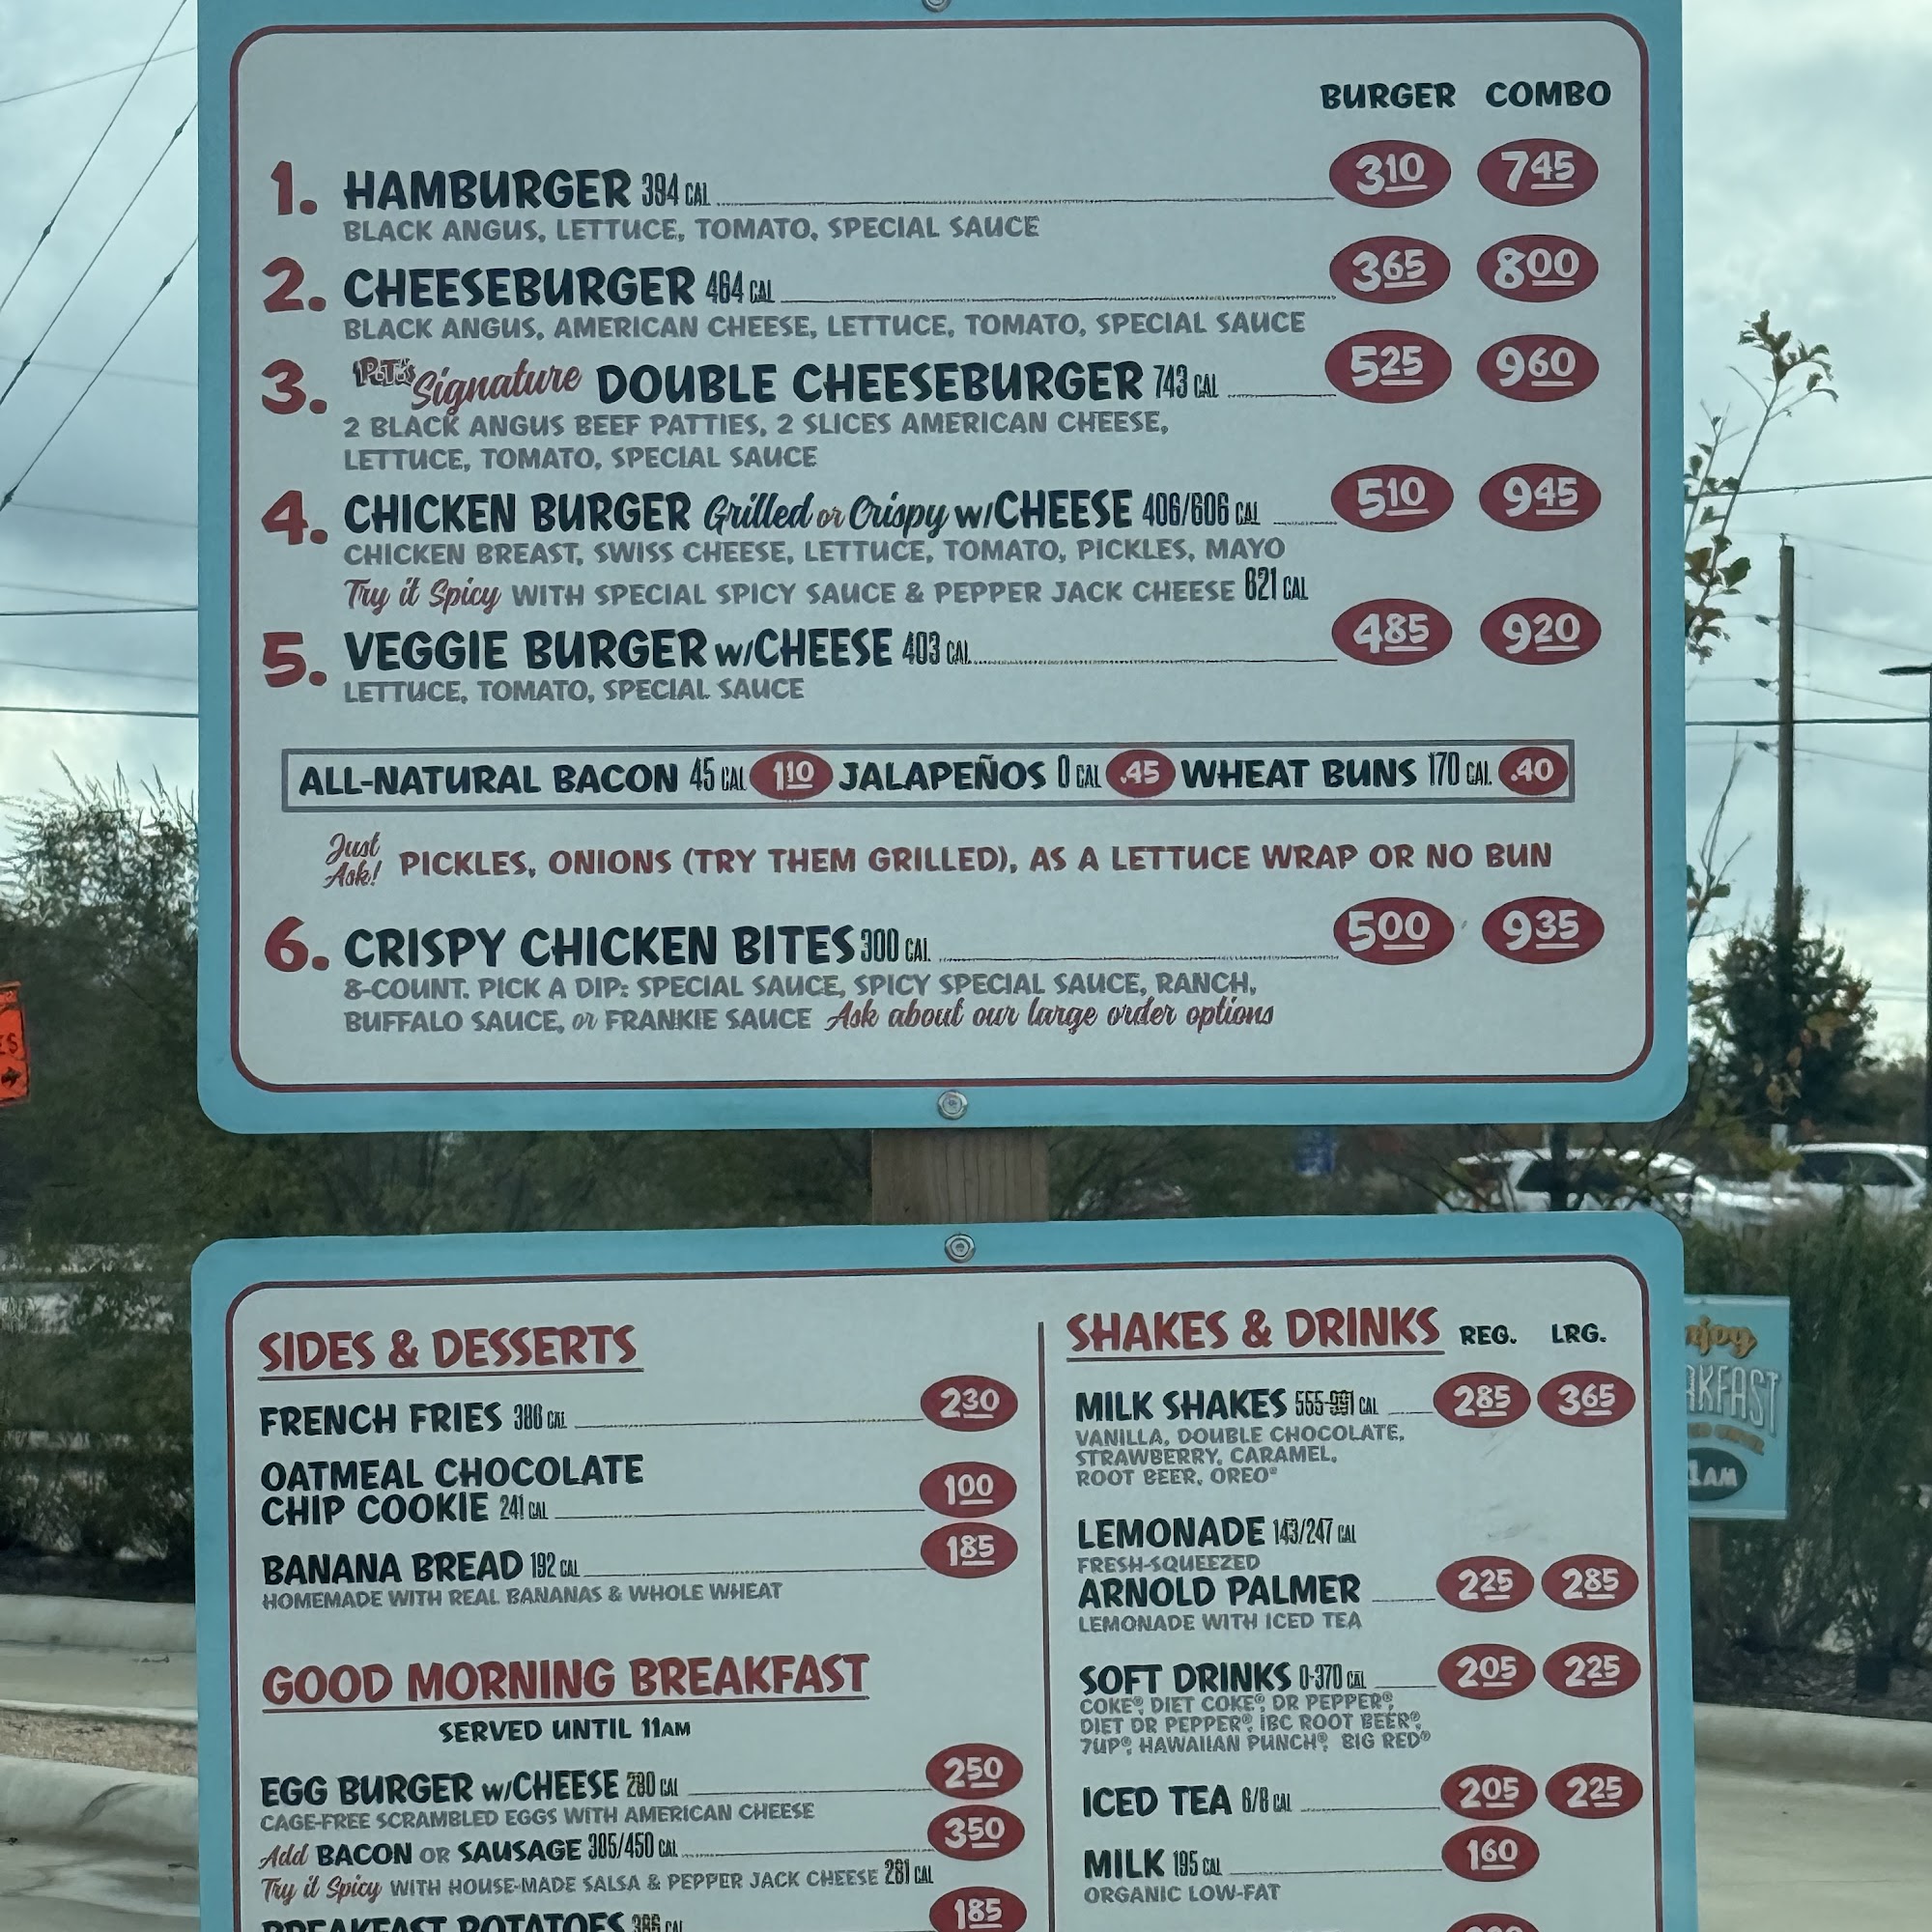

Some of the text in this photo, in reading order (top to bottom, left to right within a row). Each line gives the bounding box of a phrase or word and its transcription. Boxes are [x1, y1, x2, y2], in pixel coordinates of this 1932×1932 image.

[1320, 80, 1611, 109] BURGER COMBO
[270, 159, 319, 215] 1.
[343, 169, 631, 211] HAMBURGER
[641, 173, 679, 207] 394
[685, 183, 711, 207] CAL
[343, 215, 1039, 243] BLACK ANGUS, LETTUCE, TOMATO, SPECIAL SAUCE
[262, 256, 327, 313] 2.
[344, 267, 696, 308] CHEESEBURGER
[705, 270, 744, 304] 464
[748, 279, 776, 304] CAL
[343, 311, 1305, 341] BLACK ANGUS, AMERICAN CHEESE, LETTUCE, TOMATO, SPECIAL SAUCE
[261, 358, 327, 414] 3.
[411, 356, 582, 416] Signature
[596, 364, 777, 404] DOUBLE
[793, 361, 1144, 403] CHEESEBURGER
[1152, 364, 1187, 399] 743
[1194, 374, 1219, 398] CAL
[261, 489, 328, 546] 4.
[344, 493, 516, 533] CHICKEN
[530, 492, 691, 532] BURGER
[703, 493, 813, 535] Grilled
[818, 504, 844, 529] or
[849, 492, 949, 537] Crispy
[1236, 501, 1261, 526] CAL
[262, 631, 327, 688] 5.
[344, 630, 507, 670] VEGGIE
[523, 628, 707, 669] BURGER
[902, 631, 940, 665] 403
[945, 639, 972, 665] CAL
[298, 765, 541, 796] ALL-NATURAL
[553, 763, 678, 794] BACON
[690, 756, 715, 791] 45
[722, 766, 748, 791] CAL
[838, 753, 1046, 791] JALAPEÑOS
[1058, 753, 1069, 788] 0
[1076, 764, 1106, 788] CAL
[1180, 759, 1310, 788] WHEAT
[1321, 758, 1417, 787] BUNS
[1428, 752, 1460, 786] 170
[1466, 760, 1492, 785] CAL
[325, 832, 381, 867] Just
[398, 842, 1551, 878] PICKLES, ONIONS (TRY THEM GRILLED), AS A LETTUCE WRAP OR NO BUN
[322, 862, 383, 890] Ask!
[263, 915, 329, 973] 6.
[345, 927, 506, 968] CRISPY
[521, 925, 717, 967] CHICKEN
[731, 924, 855, 965] BITES
[861, 927, 899, 962] 300
[905, 938, 931, 962] CAL
[1066, 1306, 1606, 1352] SHAKES & DRINKS REG. LRG.
[259, 1324, 637, 1372] SIDES & DESSERTS
[259, 1402, 502, 1436] FRENCH FRIES
[1076, 1389, 1288, 1422] MILK SHAKES
[261, 1454, 643, 1492] OATMEAL CHOCOLATE
[261, 1492, 489, 1526] CHIP COOKIE
[1078, 1516, 1265, 1549] LEMONADE
[262, 1549, 524, 1585] BANANA BREAD
[1077, 1554, 1261, 1574] FRESH-SQUEEZED
[262, 1582, 782, 1610] HOMEMADE WITH REAL BANANAS & WHOLE WHEAT
[1078, 1574, 1360, 1609] ARNOLD PALMER
[1079, 1611, 1362, 1633] LEMONADE WITH ICED TEA
[263, 1654, 870, 1705] GOOD MORNING BREAKFAST
[1079, 1662, 1292, 1697] SOFT DRINKS
[439, 1718, 691, 1743] SERVED UNTIL 11AM
[260, 1776, 327, 1807] EGG
[335, 1773, 473, 1805] BURGER
[1083, 1785, 1233, 1818] ICED TEA
[261, 1803, 815, 1832] CAGE-FREE SCRAMBLED EGGS WITH AMERICAN CHEESE
[315, 1842, 412, 1866] BACON
[419, 1847, 450, 1863] OR
[457, 1838, 582, 1863] SAUSAGE
[1085, 1848, 1165, 1880] MILK
[1084, 1883, 1281, 1904] ORGANIC LOW-FAT
